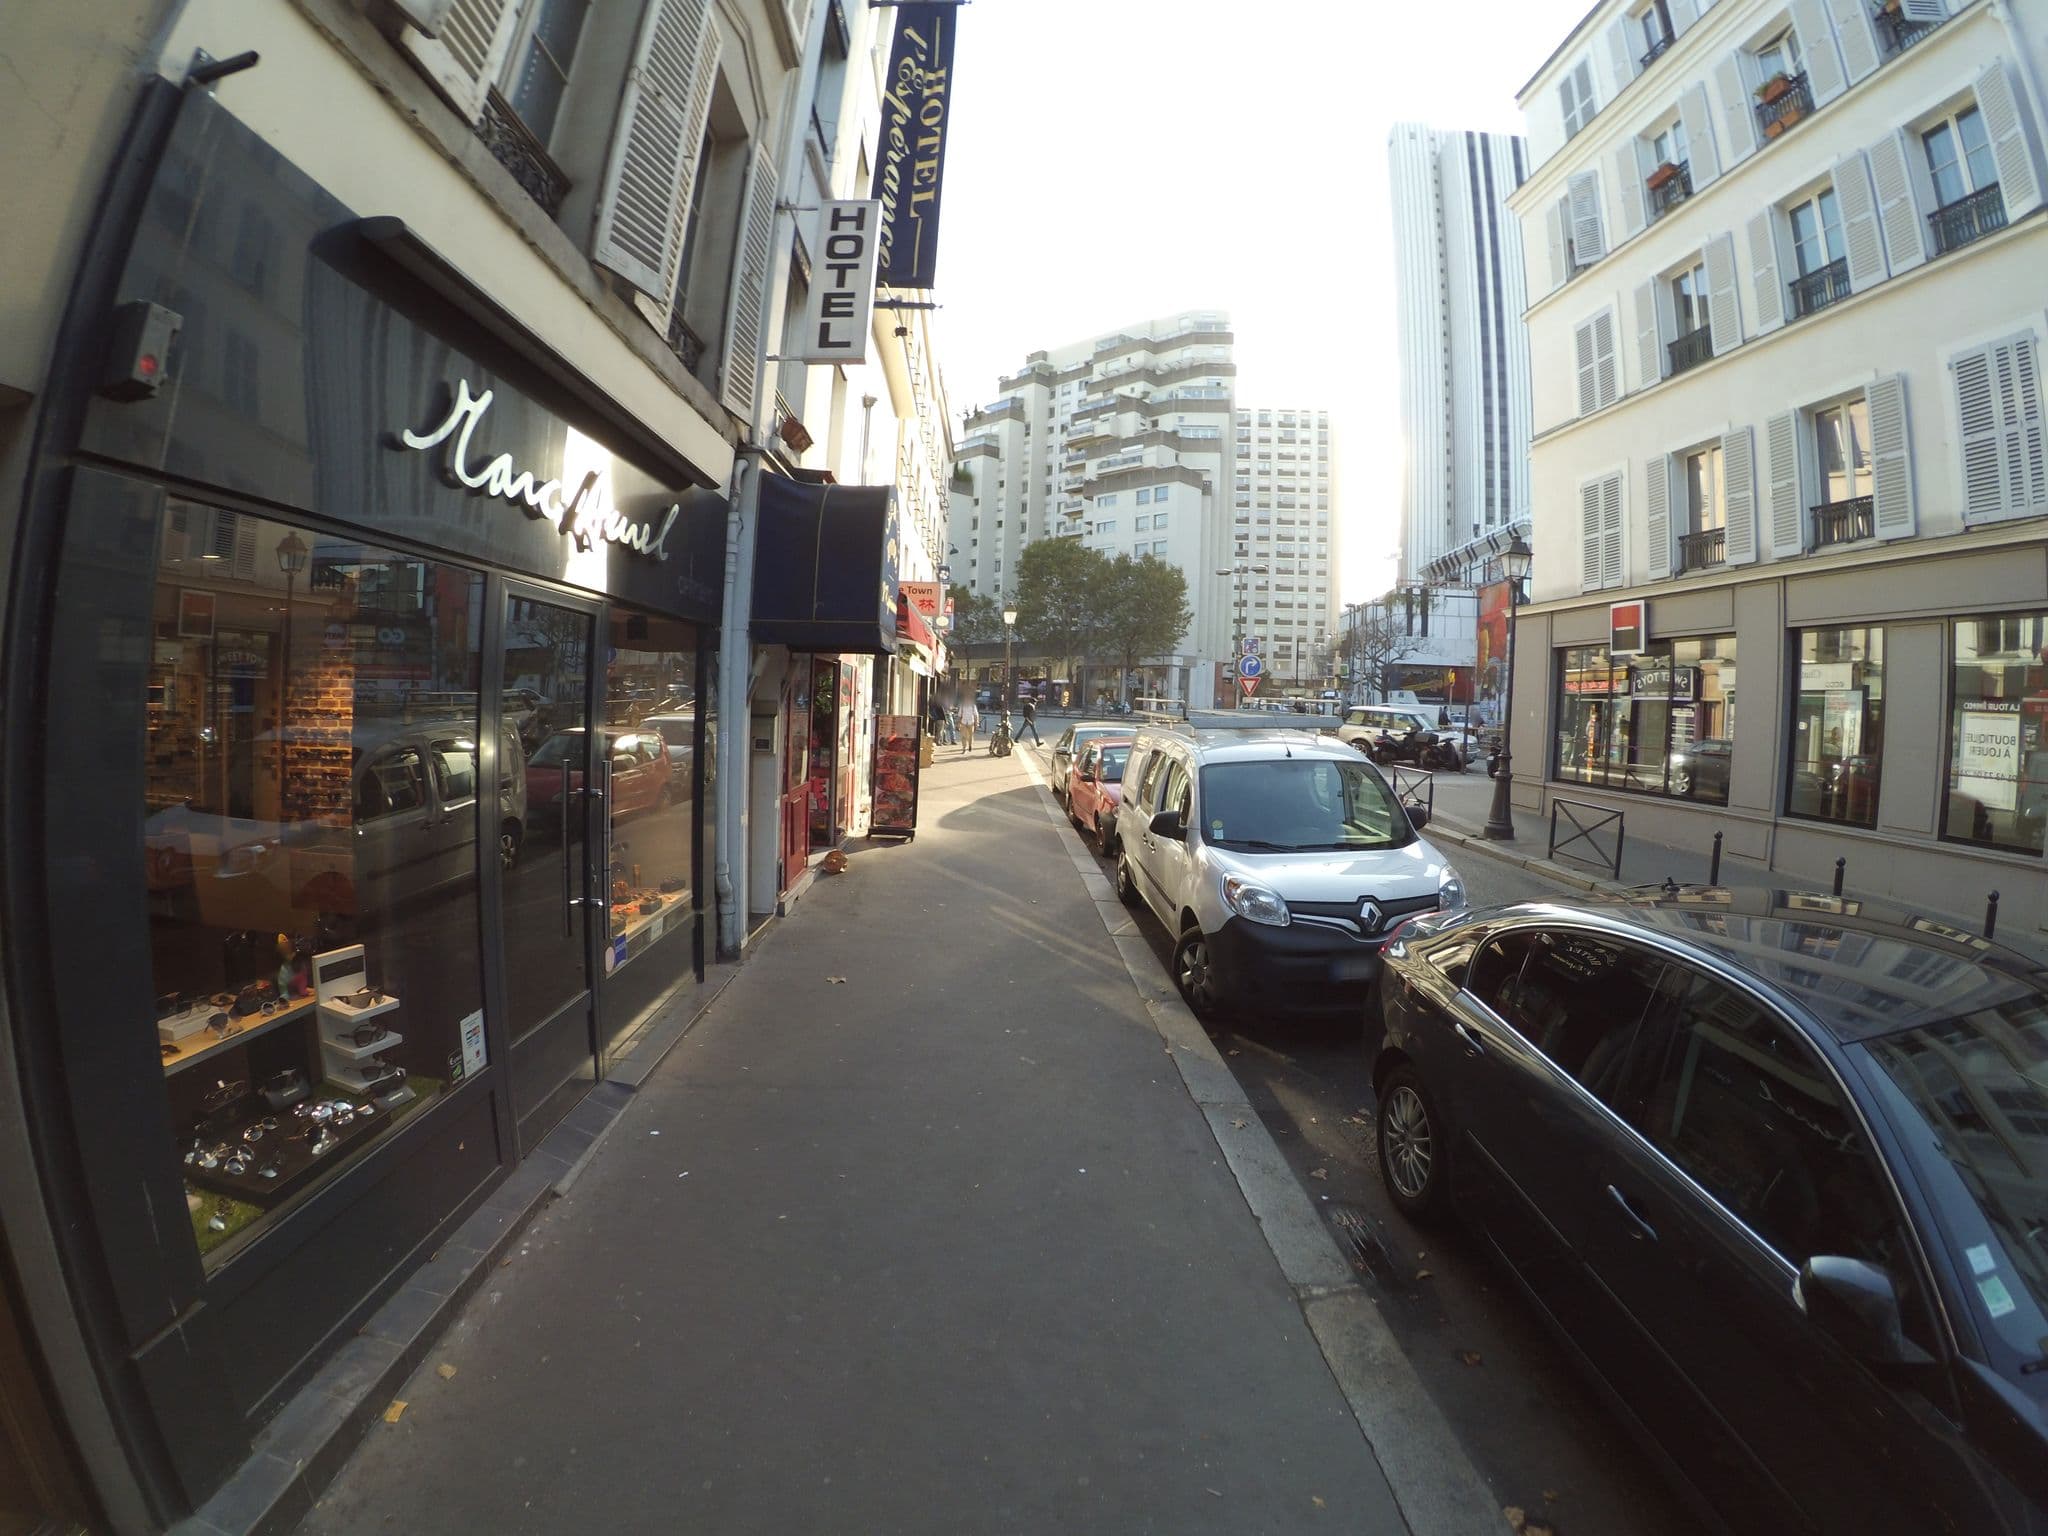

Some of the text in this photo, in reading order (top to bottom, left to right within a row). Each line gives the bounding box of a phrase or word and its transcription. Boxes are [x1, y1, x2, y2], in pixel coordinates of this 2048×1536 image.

[908, 67, 947, 218] HOTEL
[818, 207, 867, 349] HOTEL
[907, 585, 933, 595] Town
